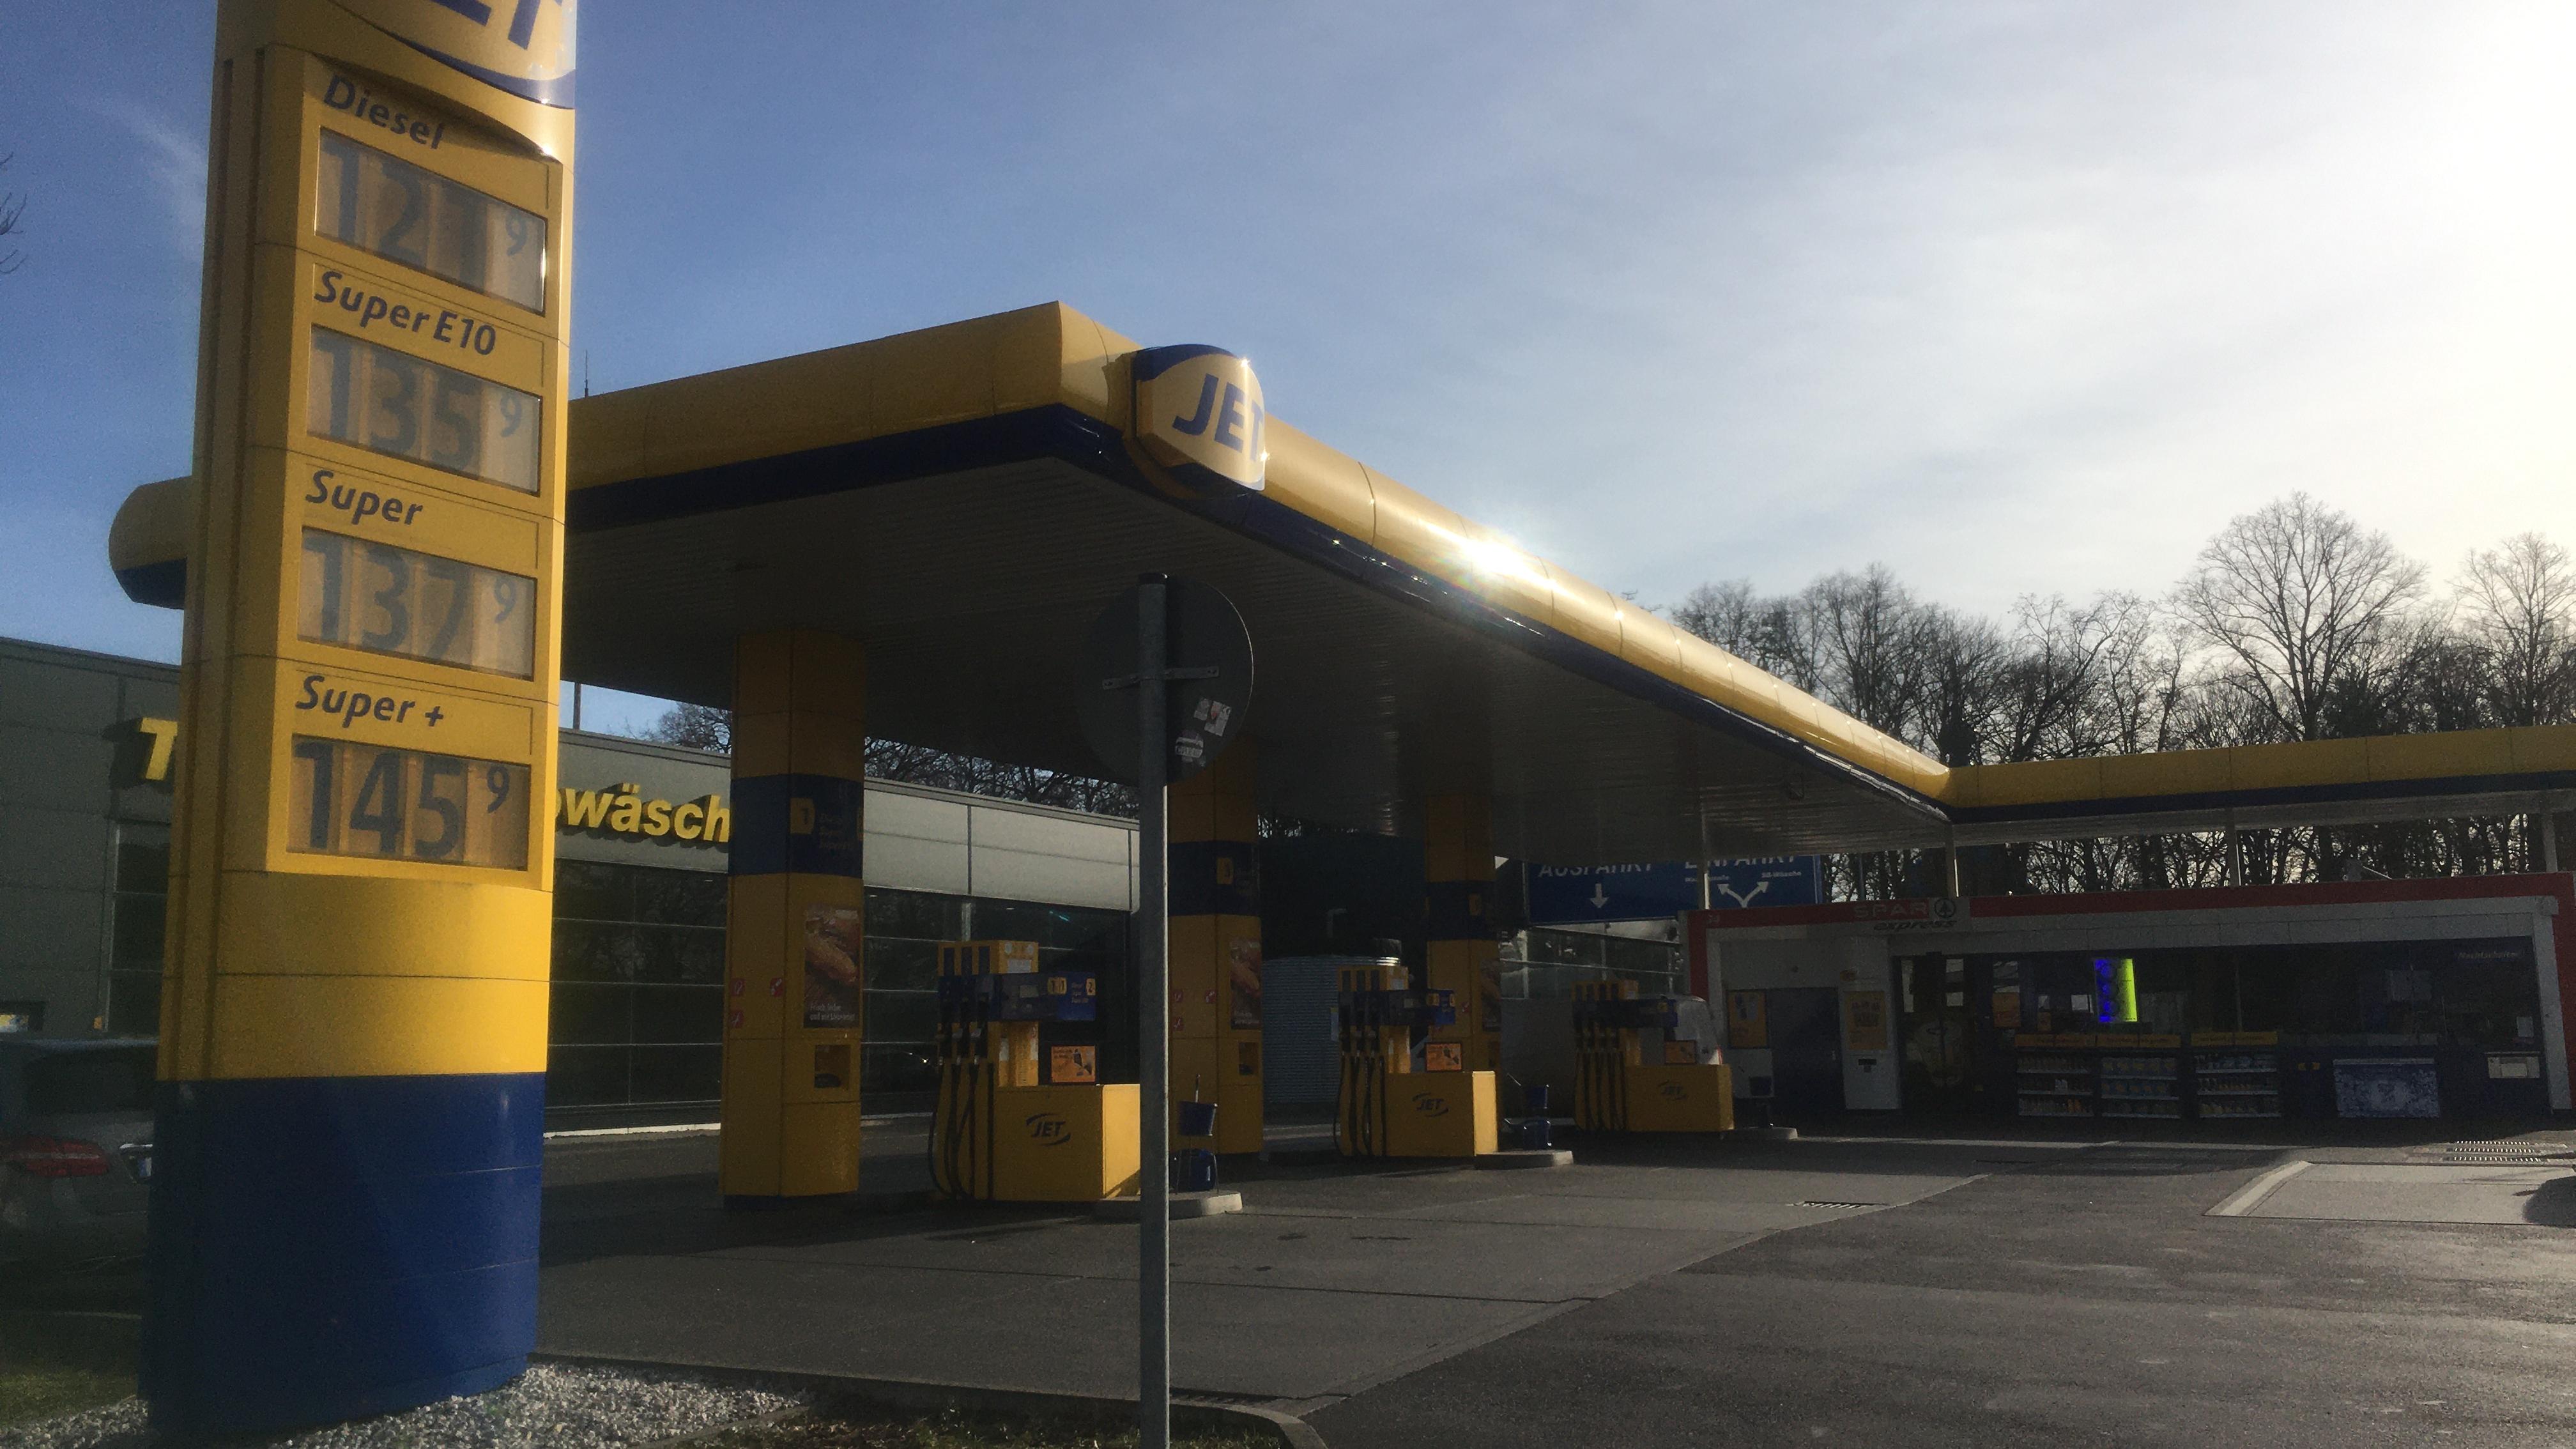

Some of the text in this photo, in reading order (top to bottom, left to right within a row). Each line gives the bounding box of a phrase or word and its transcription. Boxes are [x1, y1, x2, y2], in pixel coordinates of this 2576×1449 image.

[323, 75, 445, 150] Diesel
[314, 270, 496, 356] Super E10
[1172, 372, 1264, 463] JET
[305, 469, 424, 525] Super
[295, 675, 444, 728] Super +
[555, 781, 730, 843] wäsch
[1853, 901, 1928, 918] SPAR
[1030, 1121, 1066, 1137] JET
[1416, 1098, 1445, 1111] JET
